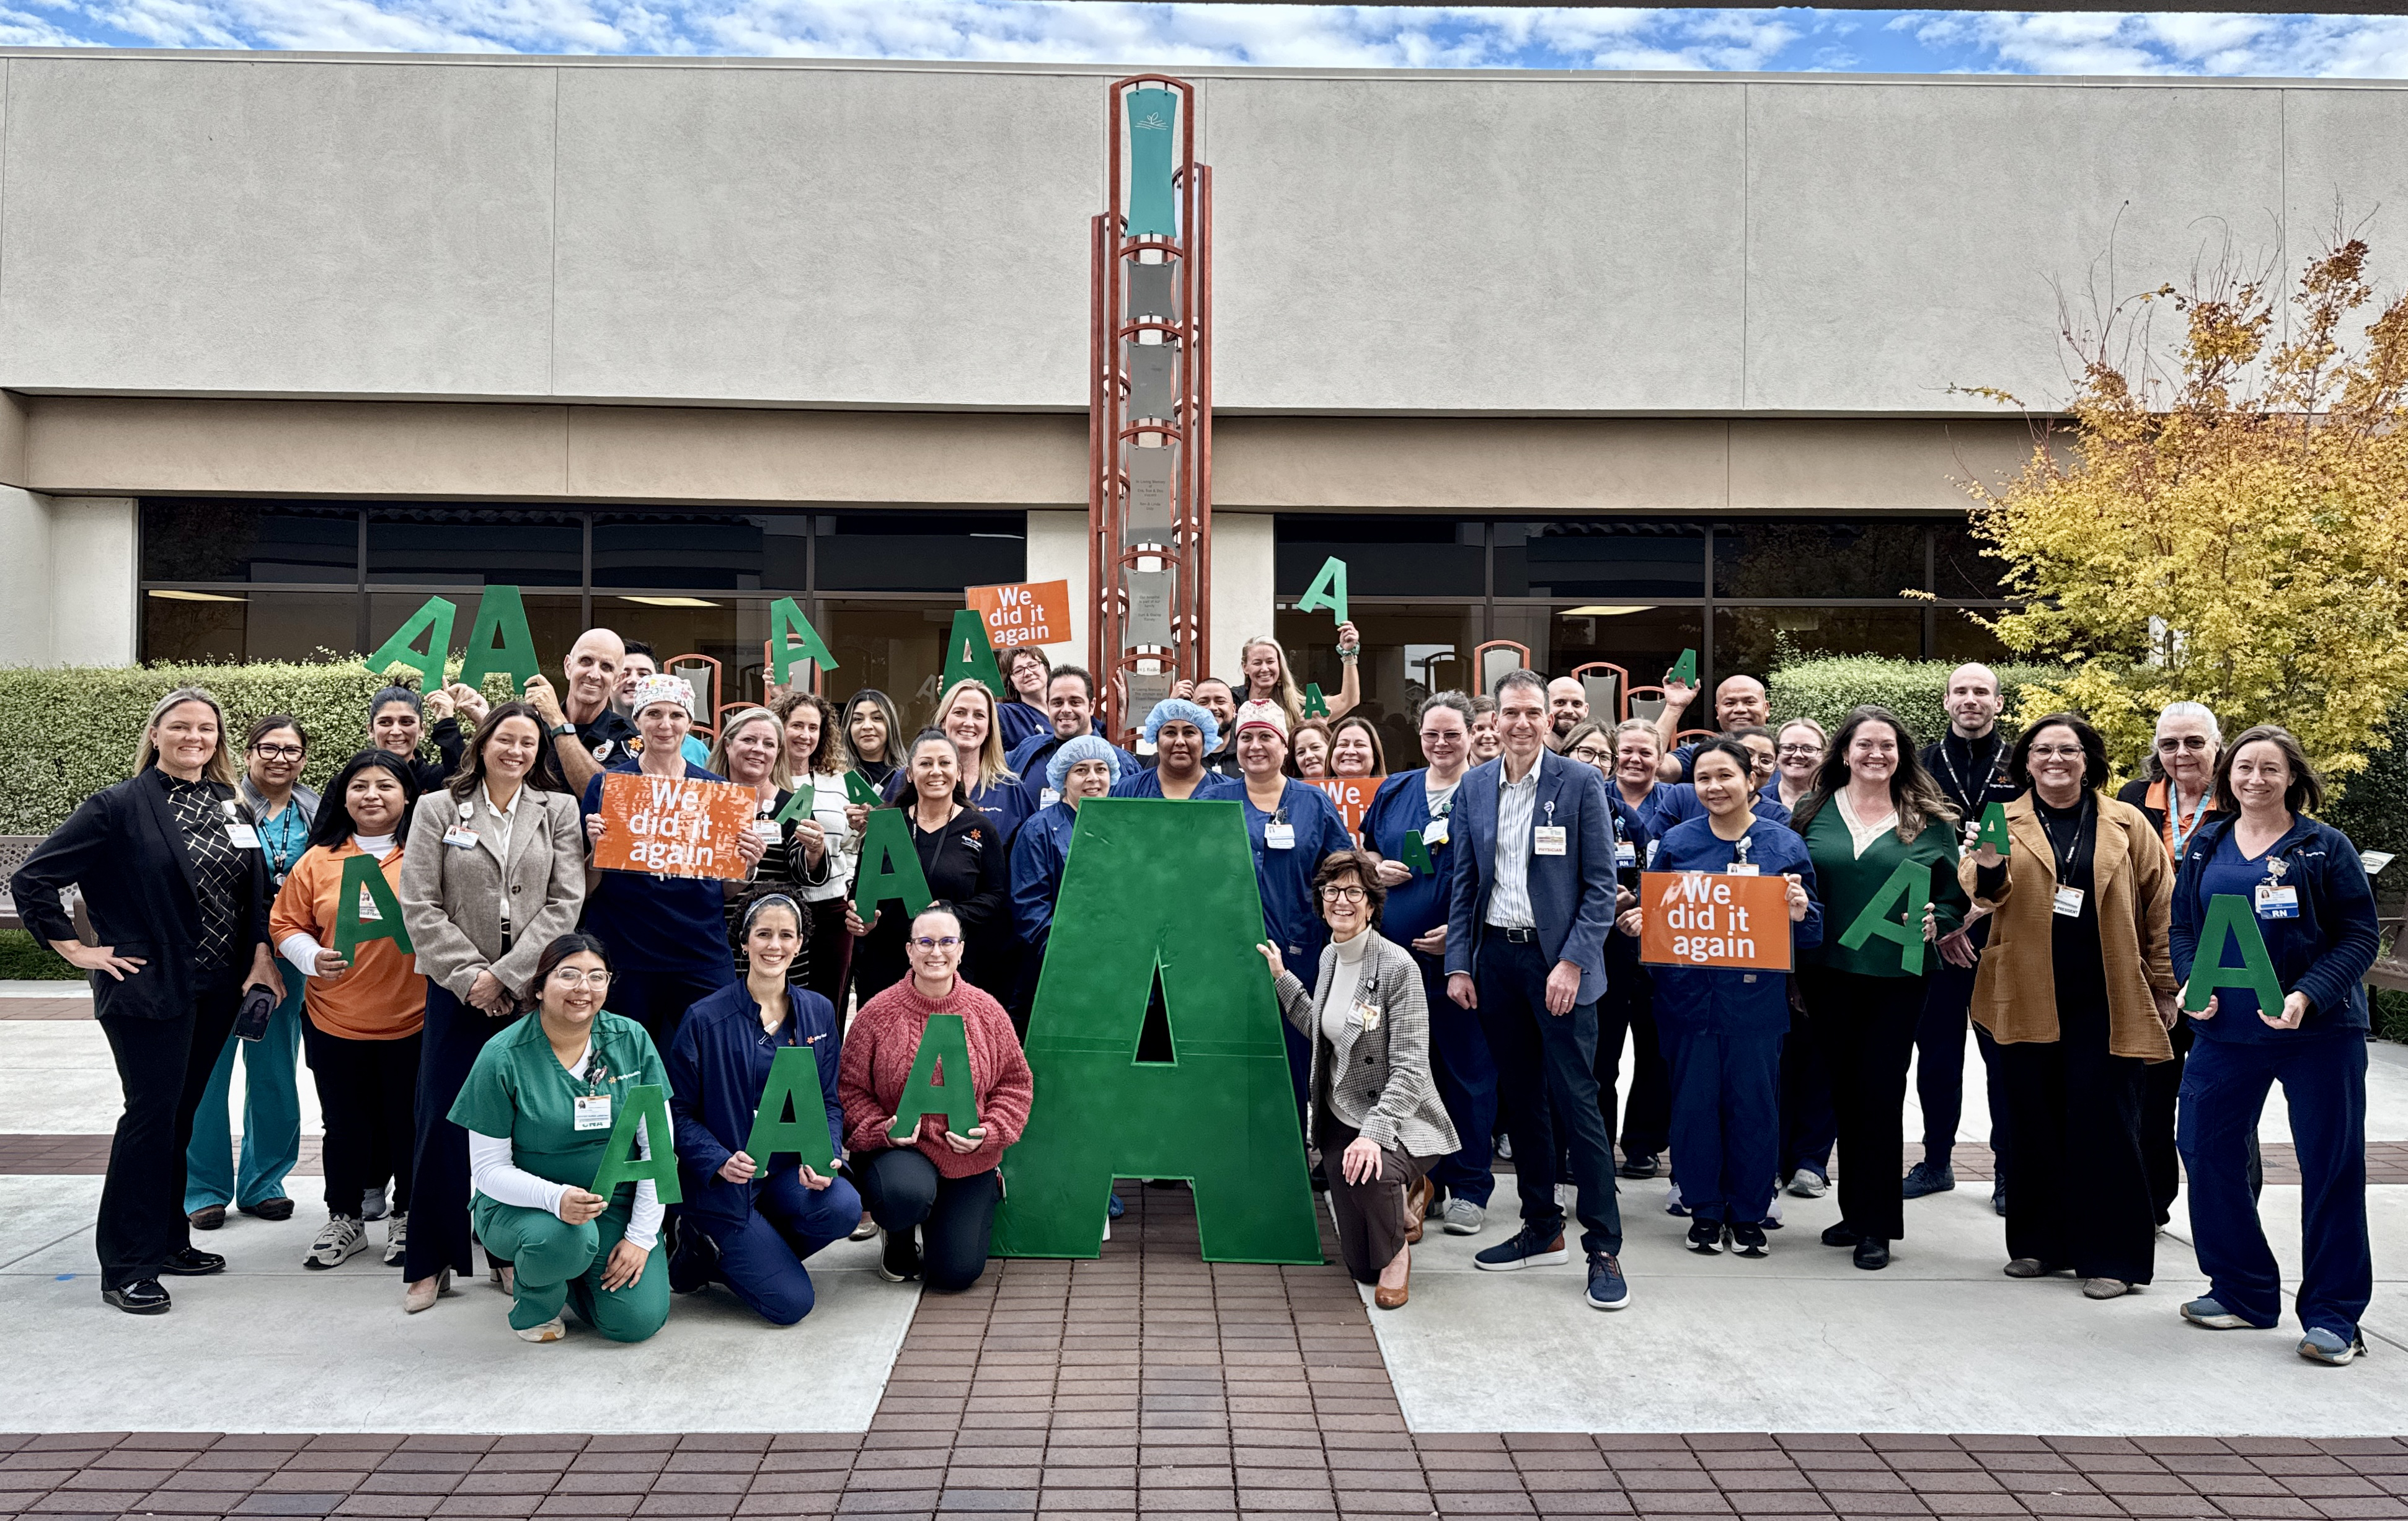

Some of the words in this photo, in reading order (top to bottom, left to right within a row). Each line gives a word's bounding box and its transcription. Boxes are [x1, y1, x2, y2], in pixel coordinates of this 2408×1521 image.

[998, 586, 1032, 607] We
[1297, 555, 1348, 627] A
[989, 606, 1022, 627] did
[1030, 604, 1045, 623] it
[994, 622, 1050, 646] again
[365, 595, 456, 695] A
[459, 585, 540, 695] A
[770, 596, 839, 686] A
[941, 609, 1007, 700] A
[1668, 648, 1697, 689] A
[1304, 682, 1330, 719] A
[652, 780, 699, 811] We
[775, 783, 815, 826] A
[843, 769, 884, 808] A
[1319, 781, 1361, 805] We
[629, 808, 679, 837] did
[691, 812, 713, 840] it
[1972, 801, 2011, 856] A
[629, 838, 714, 869] again
[854, 808, 934, 924] A
[1402, 830, 1435, 875] A
[335, 854, 414, 967] A
[1683, 876, 1731, 905] We
[2057, 906, 2078, 914] PRESIDENT
[1668, 903, 1715, 930] did
[1729, 905, 1749, 932] it
[1838, 858, 1931, 976] A
[2272, 909, 2288, 918] RN
[1673, 931, 1755, 963] again
[2183, 894, 2285, 1018] A
[994, 797, 1324, 1264] A
[888, 1013, 981, 1139] A
[745, 1046, 838, 1178] A
[590, 1083, 683, 1210] A
